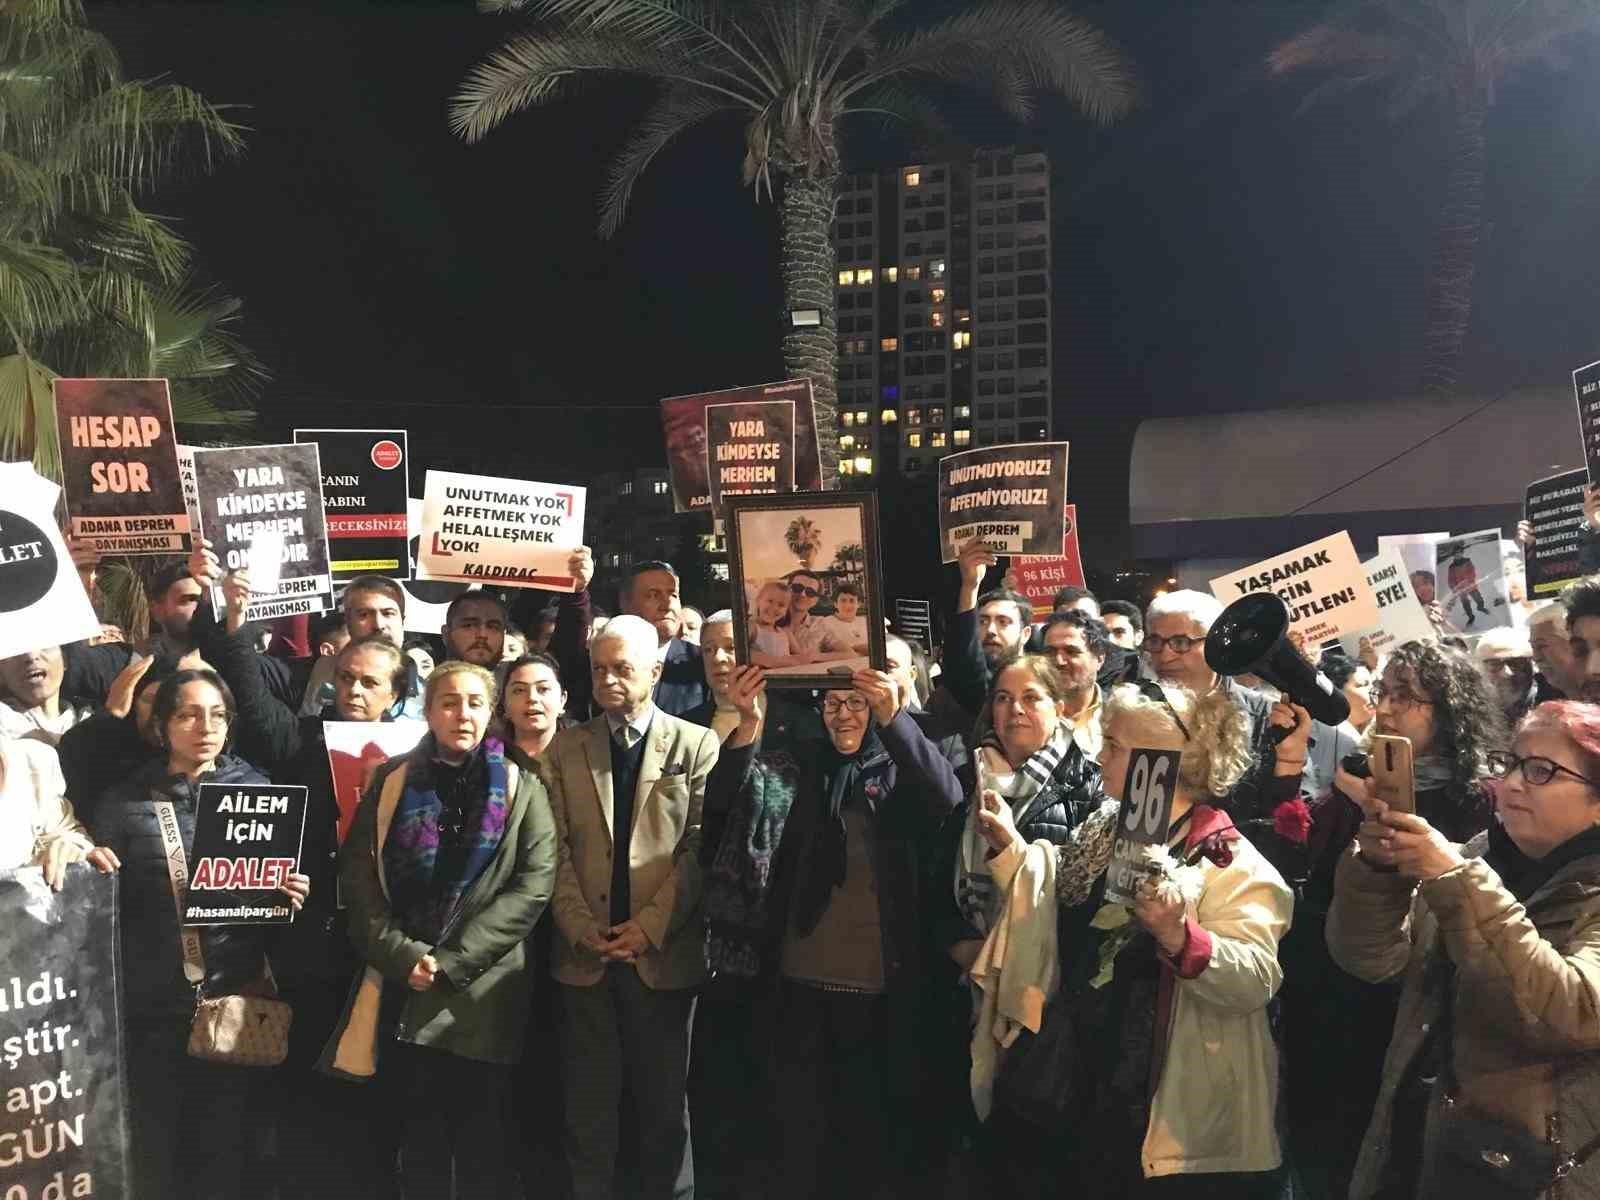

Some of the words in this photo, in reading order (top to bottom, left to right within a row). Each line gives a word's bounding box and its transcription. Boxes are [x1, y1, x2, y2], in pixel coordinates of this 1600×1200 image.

[70, 416, 161, 448] HESAP
[729, 420, 765, 438] YARA
[716, 441, 780, 461] KİMDEYSE
[91, 462, 152, 493] SOR
[233, 466, 285, 488] YARA
[720, 466, 776, 483] MERHEM
[950, 459, 1051, 485] UNUTMUYORUZ!
[216, 491, 307, 517] KİMDEYSE
[446, 486, 530, 507] UNUTMAK
[534, 496, 566, 510] YOK
[950, 487, 1048, 513] AFFETMİYORUZ!
[80, 519, 122, 534] ADANA
[124, 517, 175, 532] DEPREM
[443, 504, 525, 523] AFFETMEK
[530, 513, 561, 526] YOK
[442, 521, 554, 543] HELALLEŞMEK
[976, 524, 1020, 537] DEPREM
[440, 539, 480, 553] YOK!
[1234, 549, 1332, 595] YAŞAMAK
[275, 577, 317, 594] EPREM
[1376, 581, 1407, 608] EYE!
[216, 791, 289, 814] AİLEM
[1124, 753, 1170, 836] 96
[160, 807, 178, 844] GUESS
[225, 819, 274, 845] İÇİN
[190, 857, 296, 890] ADALET
[186, 905, 289, 919] #hasanalpargün
[0, 1021, 80, 1069] ştir.
[6, 1070, 83, 1115] apt.
